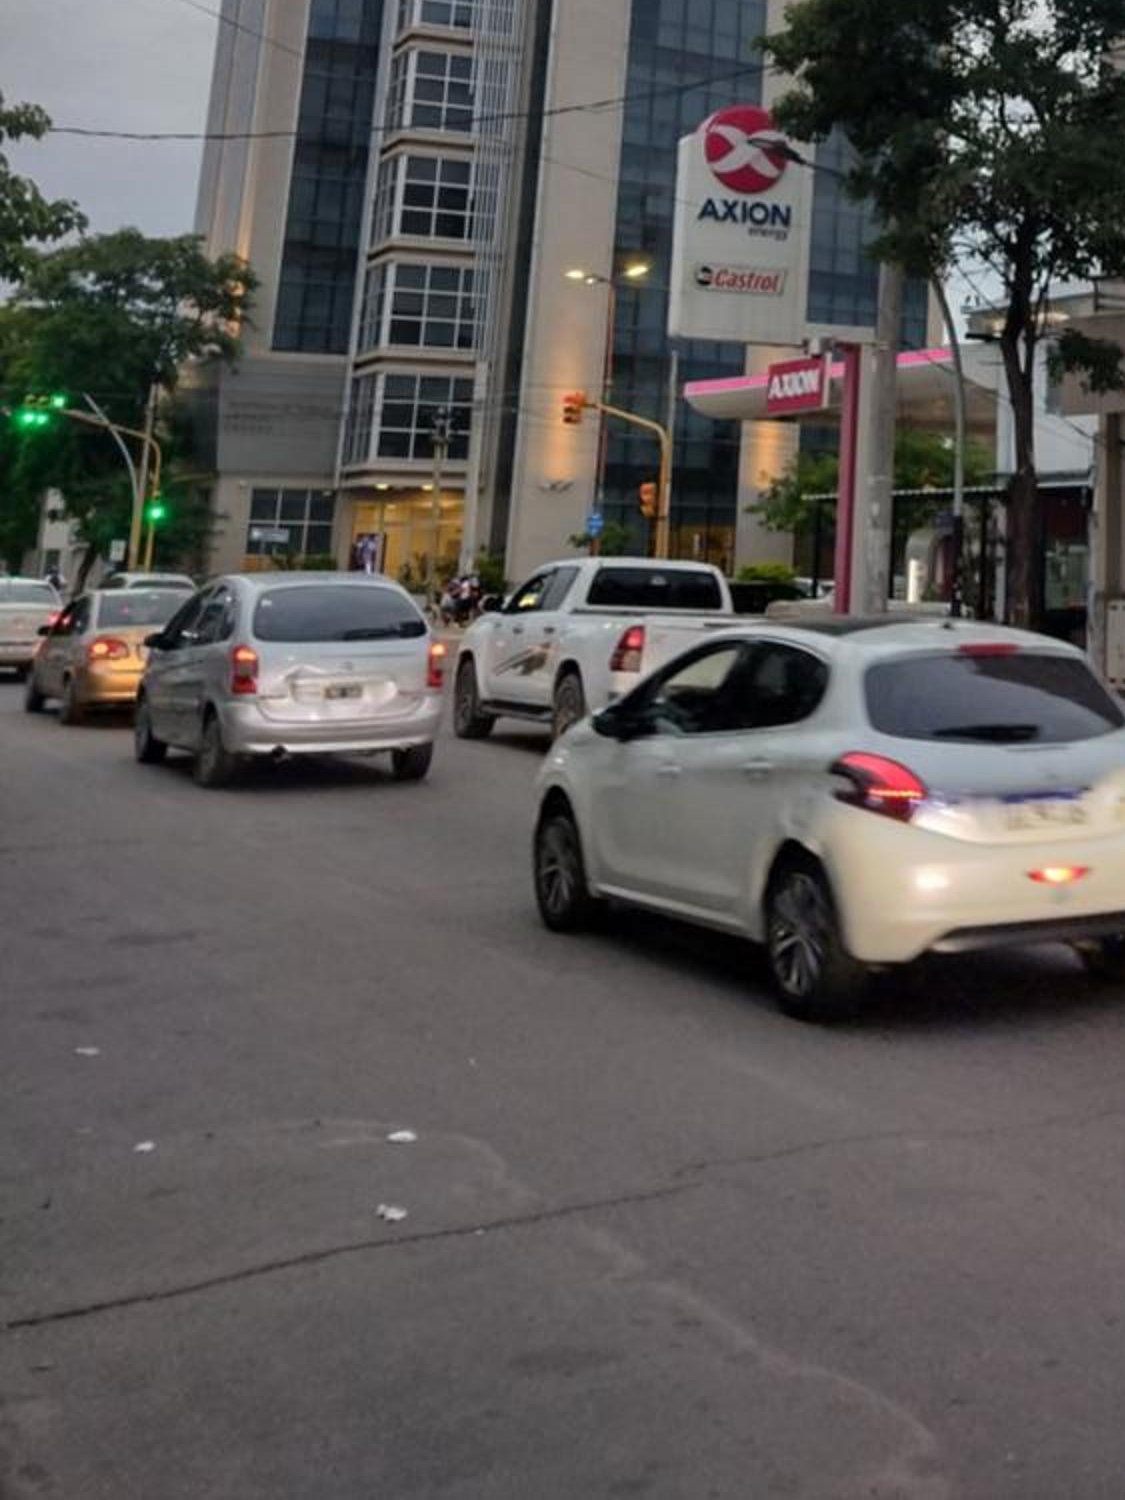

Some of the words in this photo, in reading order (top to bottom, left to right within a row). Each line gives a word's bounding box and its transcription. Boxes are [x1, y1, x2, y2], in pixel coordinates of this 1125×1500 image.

[698, 198, 791, 228] AXION
[714, 268, 779, 291] Castrol
[768, 369, 819, 399] AXION
